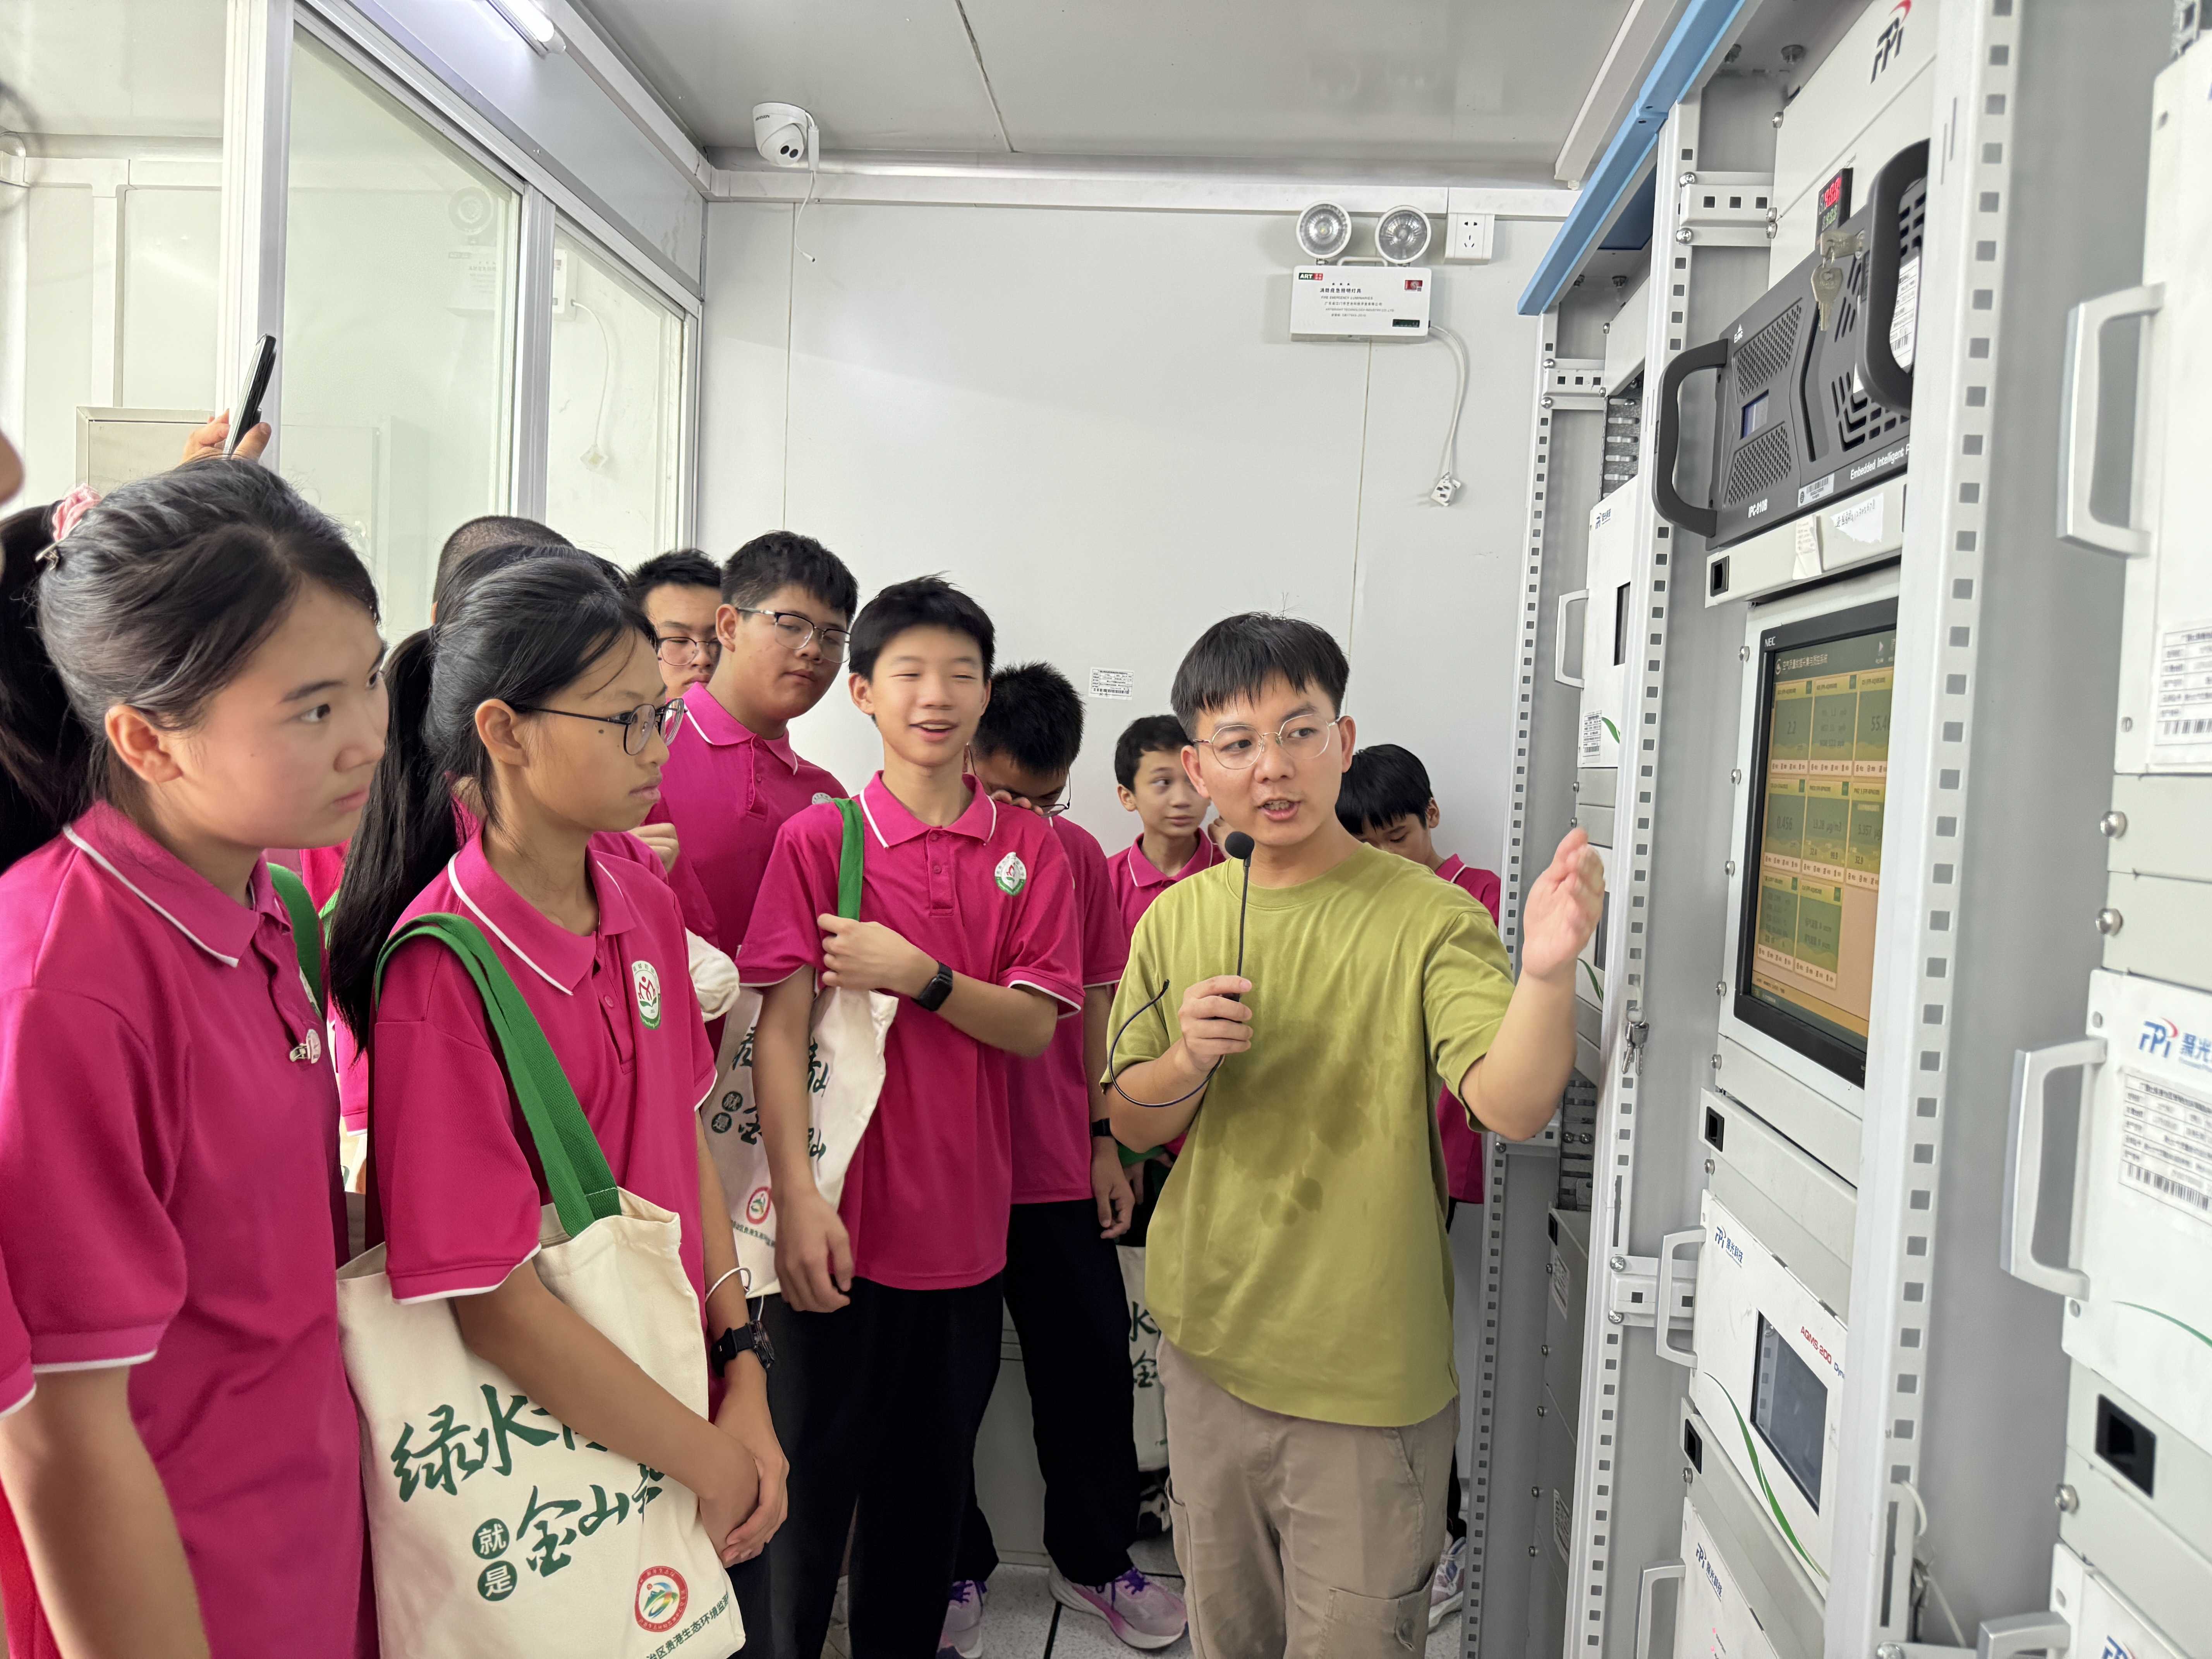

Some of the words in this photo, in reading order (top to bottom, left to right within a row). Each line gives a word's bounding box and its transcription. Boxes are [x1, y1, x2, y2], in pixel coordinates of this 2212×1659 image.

[1850, 459, 1876, 480] Embedded
[1877, 447, 1904, 468] Intelligent
[1765, 636, 1776, 647] NEC
[2179, 1032, 2212, 1063] 聚光
[1801, 1326, 1832, 1365] AQMS-200
